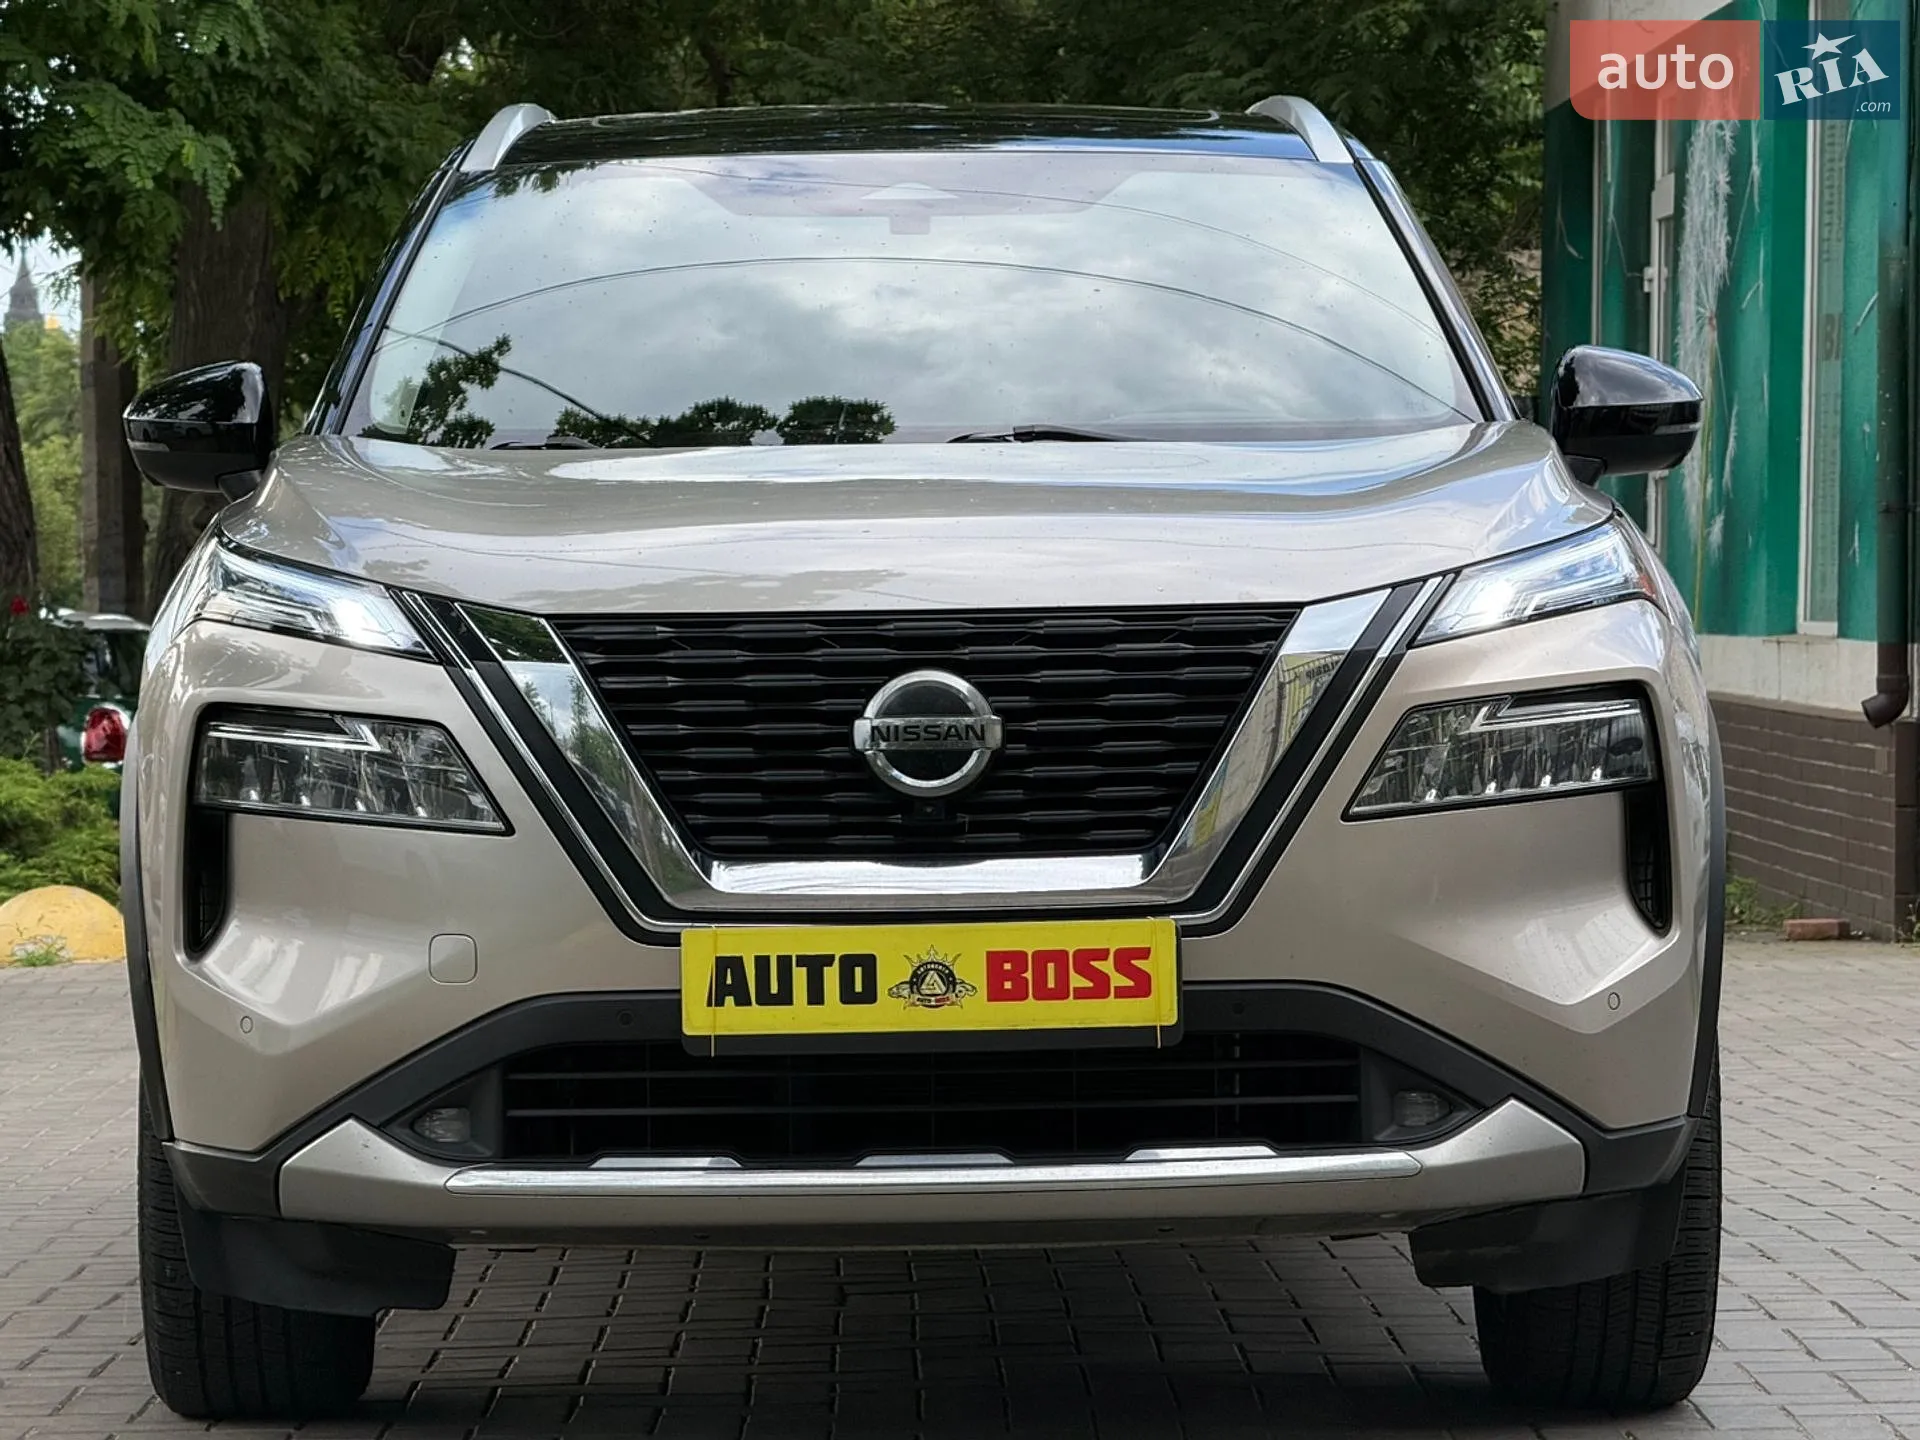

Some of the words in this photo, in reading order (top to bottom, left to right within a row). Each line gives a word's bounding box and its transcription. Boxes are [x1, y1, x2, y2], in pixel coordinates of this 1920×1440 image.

[870, 724, 986, 743] NISSAN
[706, 953, 878, 1008] AUTO
[985, 947, 1152, 1003] BOSS
